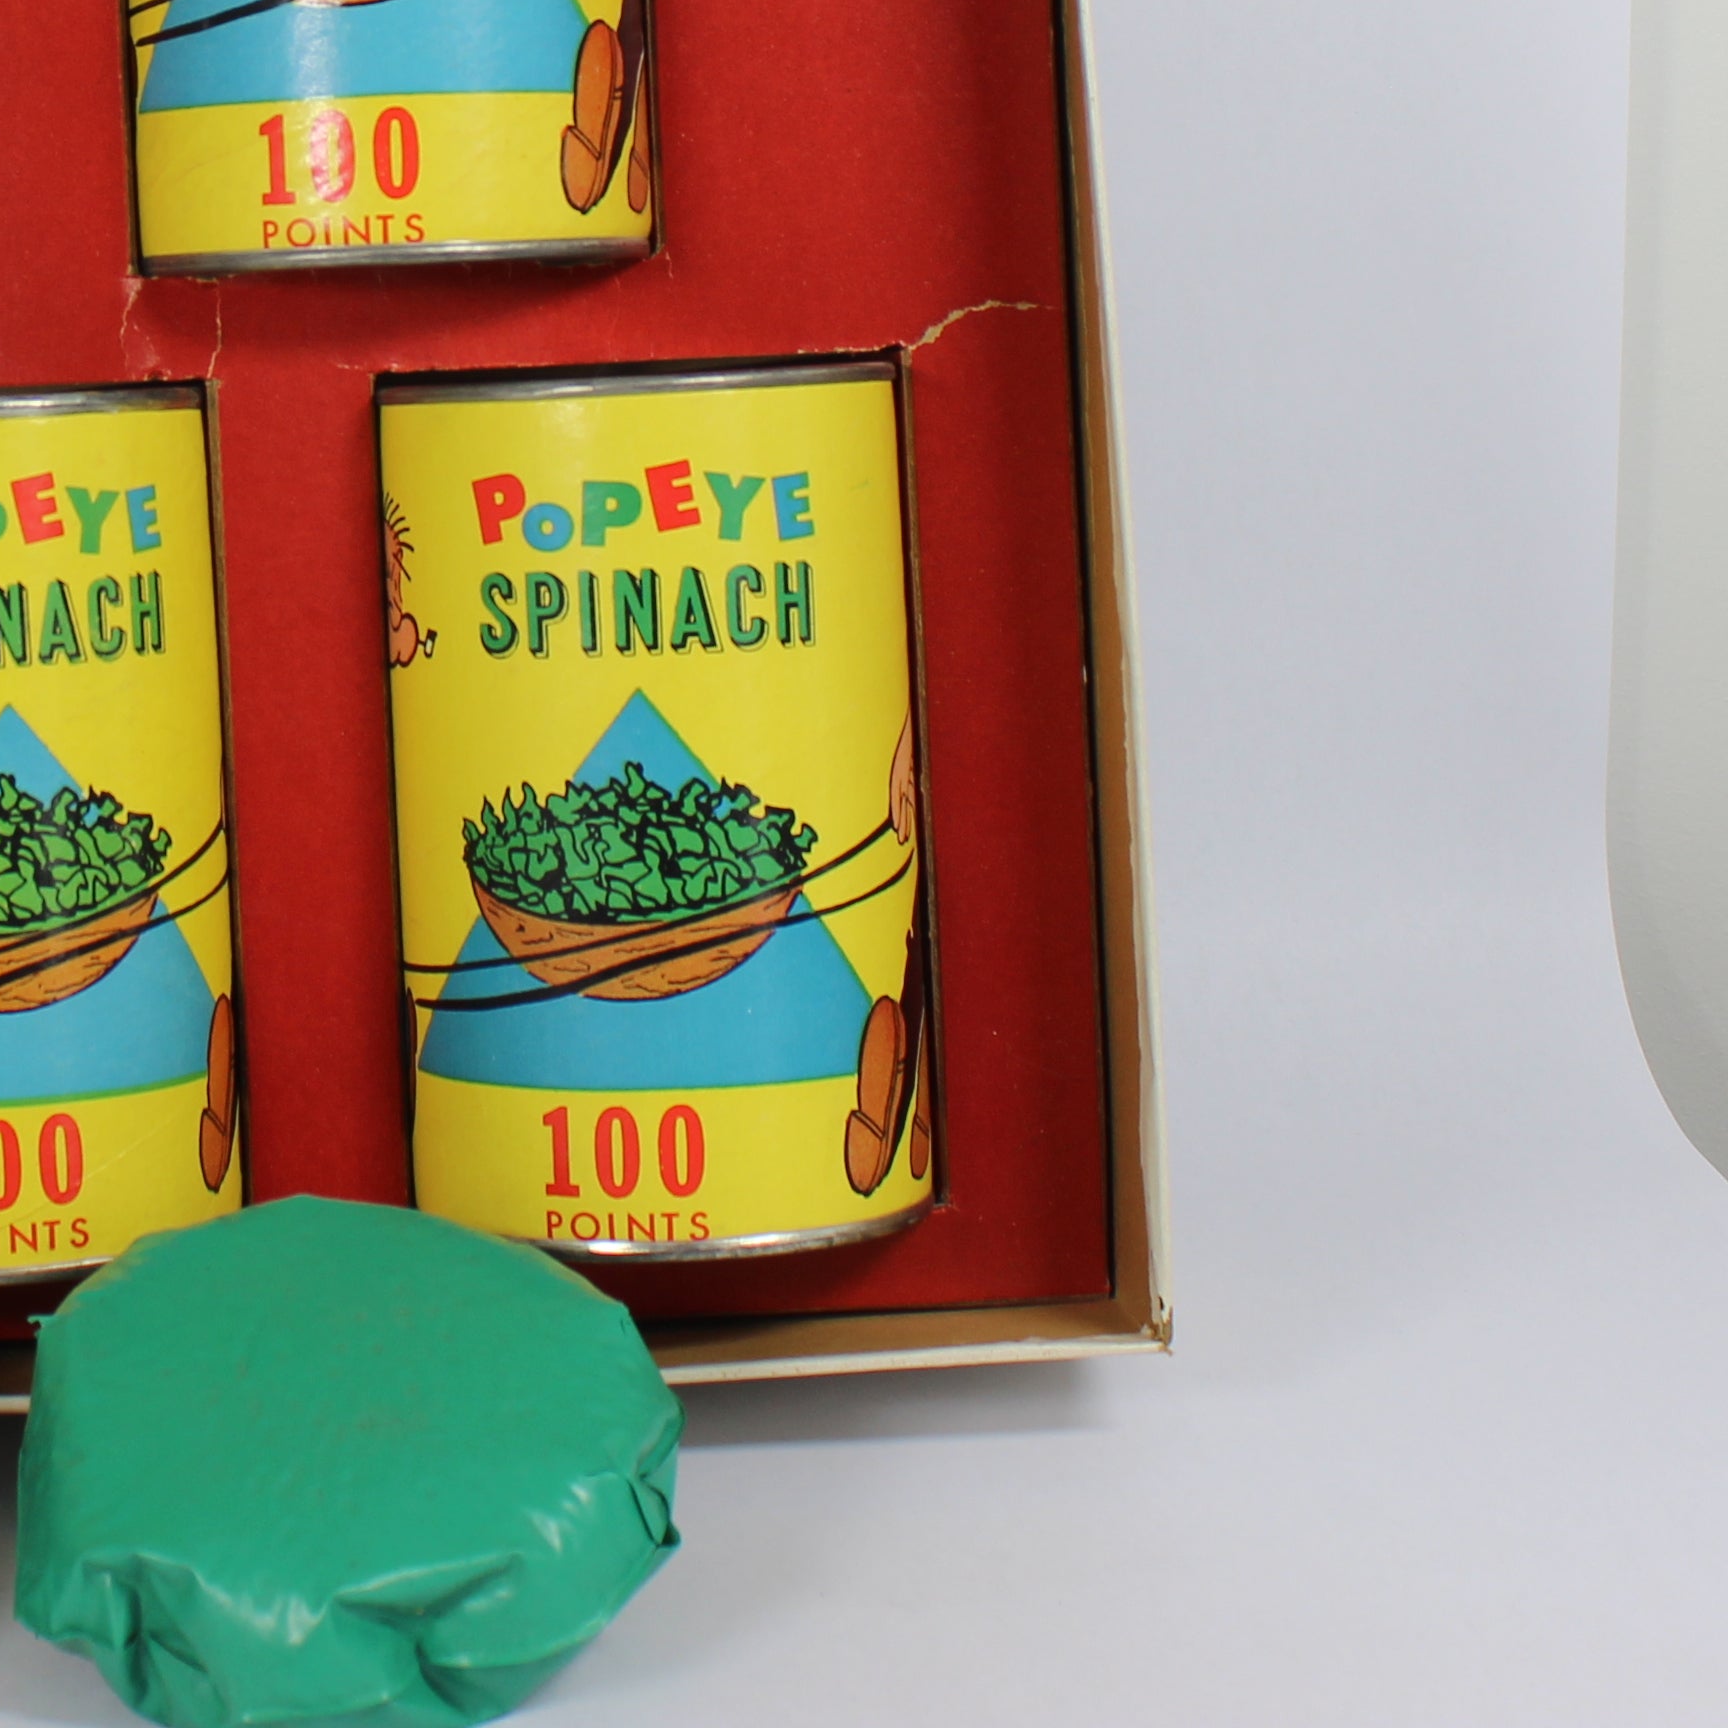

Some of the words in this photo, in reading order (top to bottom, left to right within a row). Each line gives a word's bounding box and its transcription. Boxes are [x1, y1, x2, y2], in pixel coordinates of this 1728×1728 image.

[258, 107, 421, 206] 100
[262, 214, 426, 250] POINTS
[479, 560, 816, 659] SPINACH
[541, 1104, 706, 1198] 100
[547, 1210, 711, 1243] POINTS
